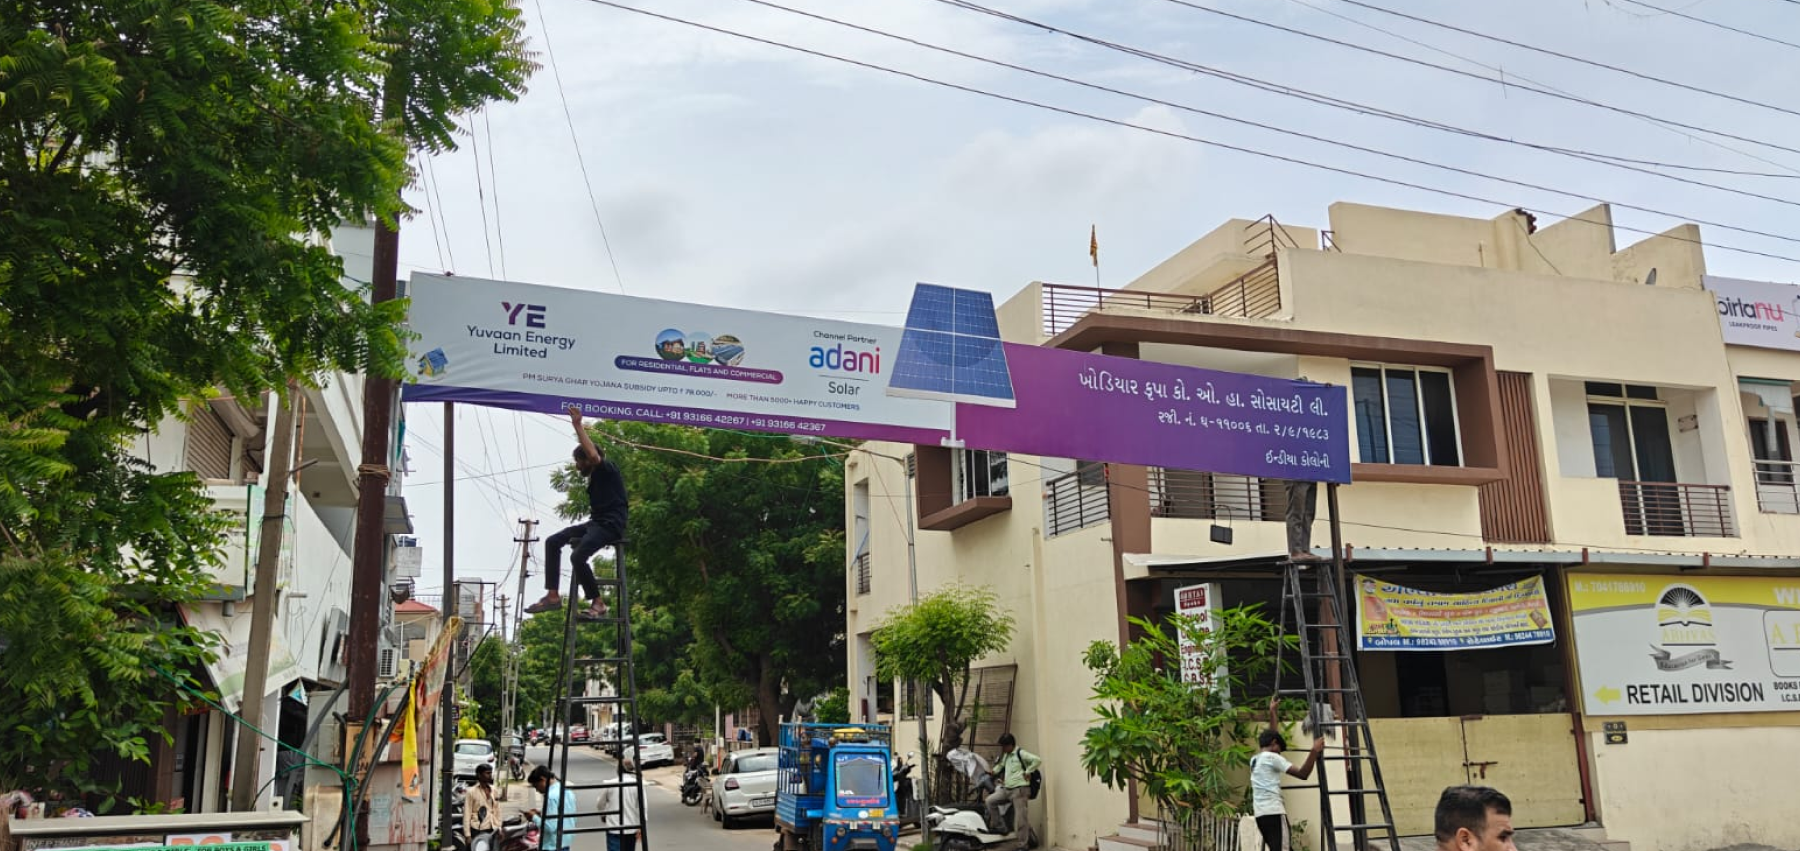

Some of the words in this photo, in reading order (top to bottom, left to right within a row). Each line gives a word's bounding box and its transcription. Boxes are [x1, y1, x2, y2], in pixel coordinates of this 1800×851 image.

[501, 301, 546, 329] YE
[467, 324, 521, 341] Yuvaan
[525, 330, 576, 351] Energy
[813, 330, 845, 341] Channel
[847, 334, 877, 344] Partner
[494, 342, 548, 358] Limited
[809, 343, 880, 374] adani
[620, 359, 637, 367] FOR
[689, 366, 711, 374] FLATS
[713, 368, 728, 376] AND
[730, 370, 777, 381] COMMERCIAL
[522, 372, 536, 380] PM
[537, 374, 563, 383] SURYA
[564, 377, 588, 386] GHAR
[589, 380, 622, 389] YOJANA
[623, 383, 656, 392] SUBSIDY
[828, 381, 860, 395] Solar
[1079, 367, 1138, 395] ખોડિયાર
[1144, 381, 1168, 401] કૃપા
[1172, 378, 1190, 401] કો.
[1225, 392, 1245, 408] હા.
[1250, 388, 1304, 415] સોસાયટી
[1309, 397, 1328, 416] લી.
[726, 393, 748, 401] MORE
[793, 399, 817, 407] HAPPY
[818, 401, 860, 411] CUSTOMERS
[665, 411, 681, 420] +91
[683, 413, 713, 422] 93166
[750, 418, 766, 427] +91
[1158, 408, 1181, 425] રજી.
[1255, 423, 1270, 435] તા.
[1627, 683, 1688, 705] RETAIL
[1692, 682, 1765, 704] DIVISION
[1773, 681, 1798, 691] BOOKS
